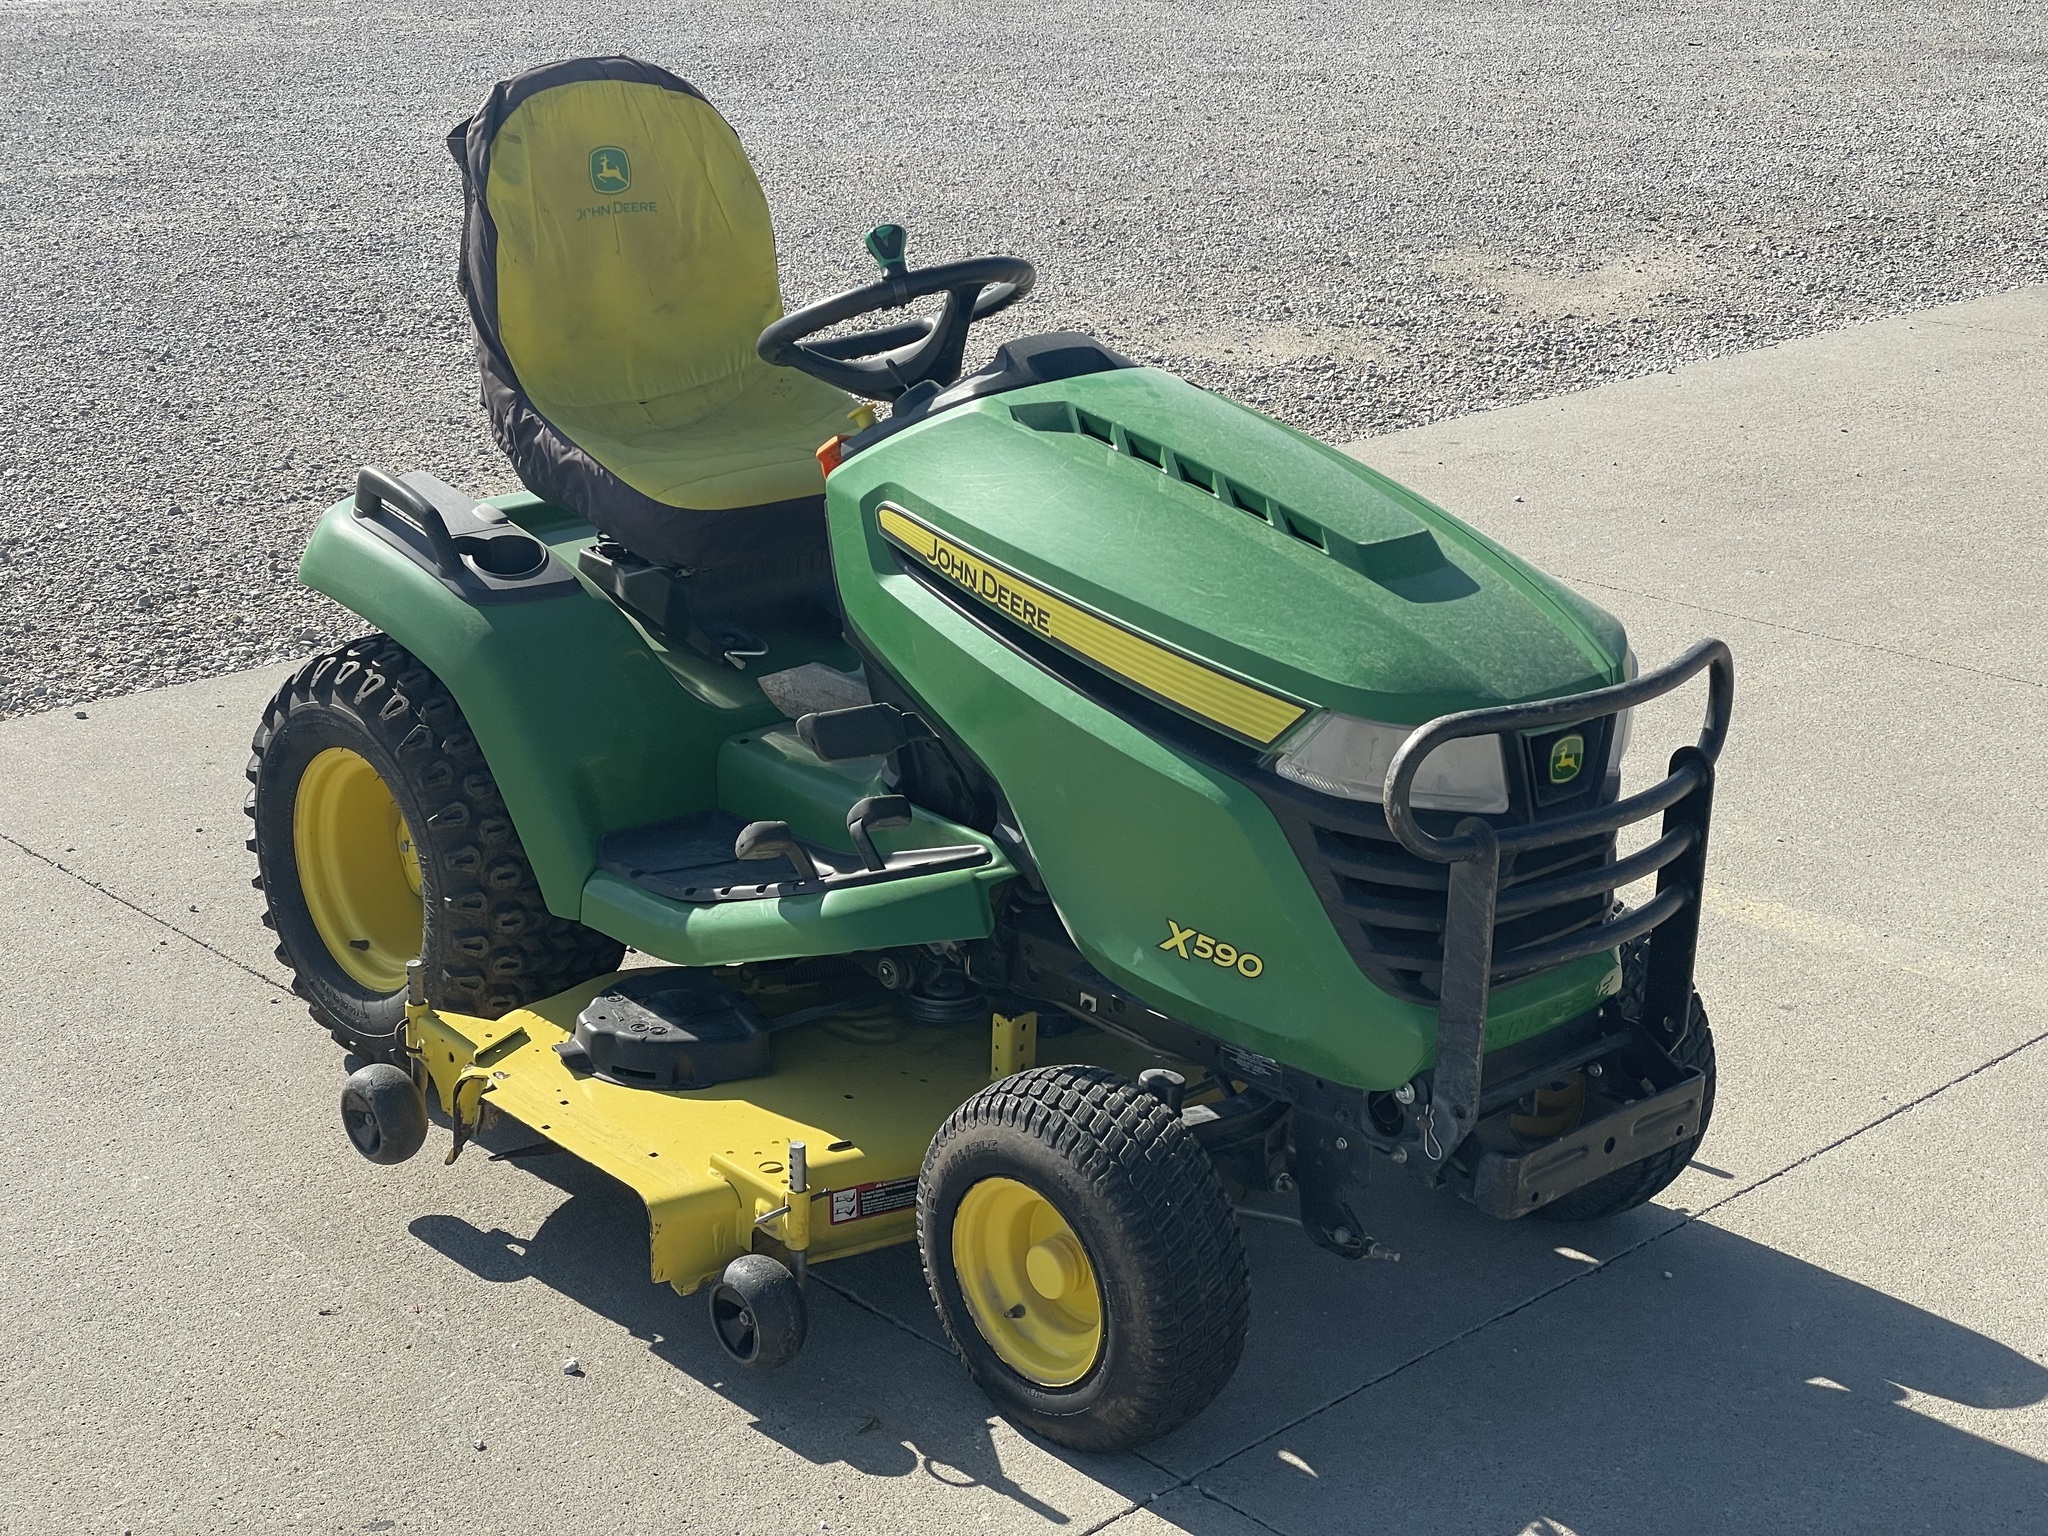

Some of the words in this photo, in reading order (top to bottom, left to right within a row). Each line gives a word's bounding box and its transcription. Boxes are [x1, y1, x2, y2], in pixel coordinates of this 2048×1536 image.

[613, 201, 658, 214] DEERE
[926, 538, 977, 590] JOHN
[982, 569, 1051, 634] DEERE
[1156, 918, 1264, 978] X590
